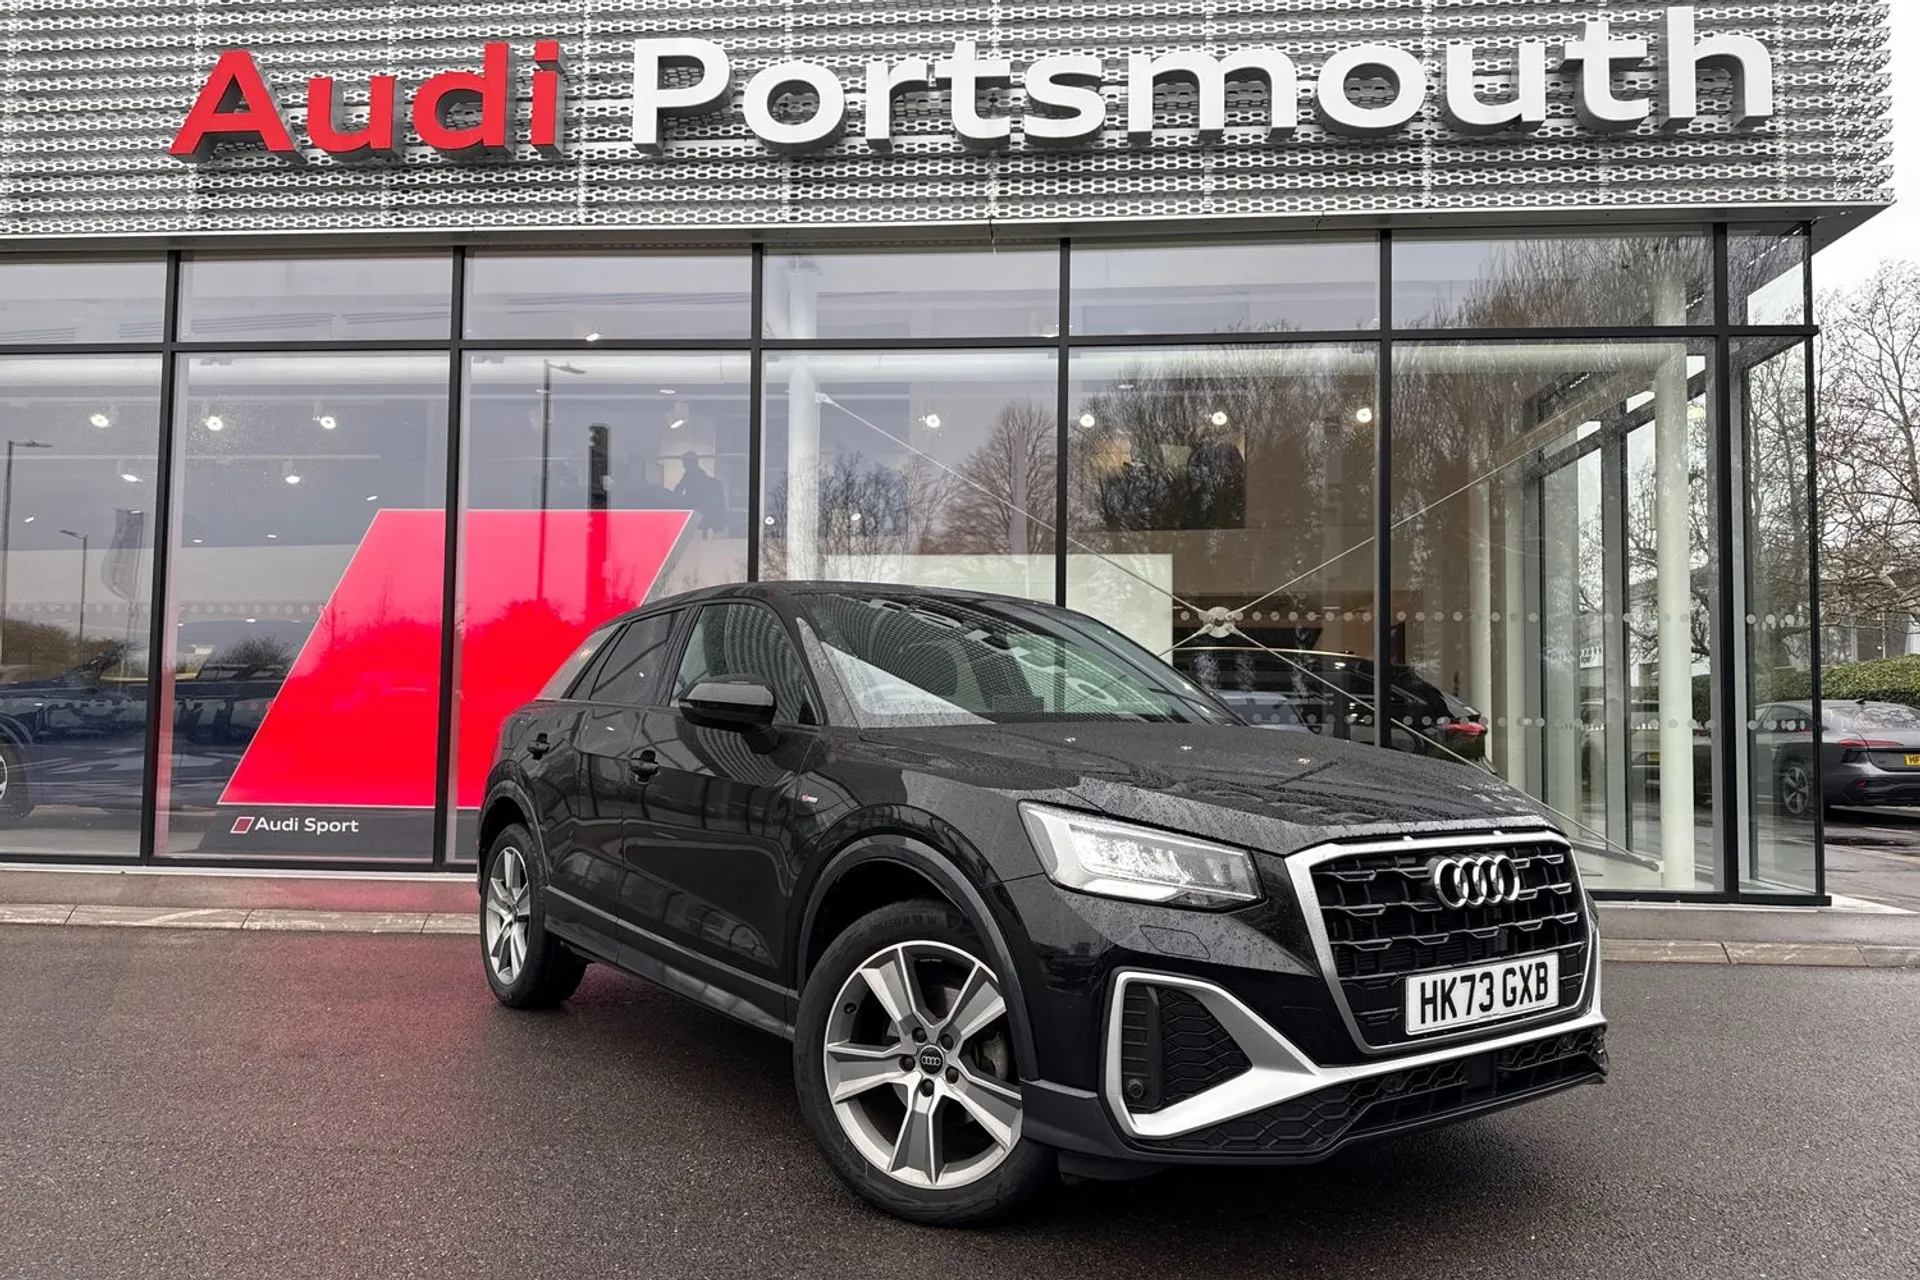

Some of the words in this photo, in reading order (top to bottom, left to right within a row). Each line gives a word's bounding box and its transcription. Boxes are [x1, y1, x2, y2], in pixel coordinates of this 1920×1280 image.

[168, 41, 560, 156] Audi
[632, 6, 1773, 146] Portsmouth
[254, 817, 299, 831] Audi
[304, 818, 359, 835] Sport
[1420, 971, 1494, 1024] HK73
[1502, 961, 1549, 1008] GXB
